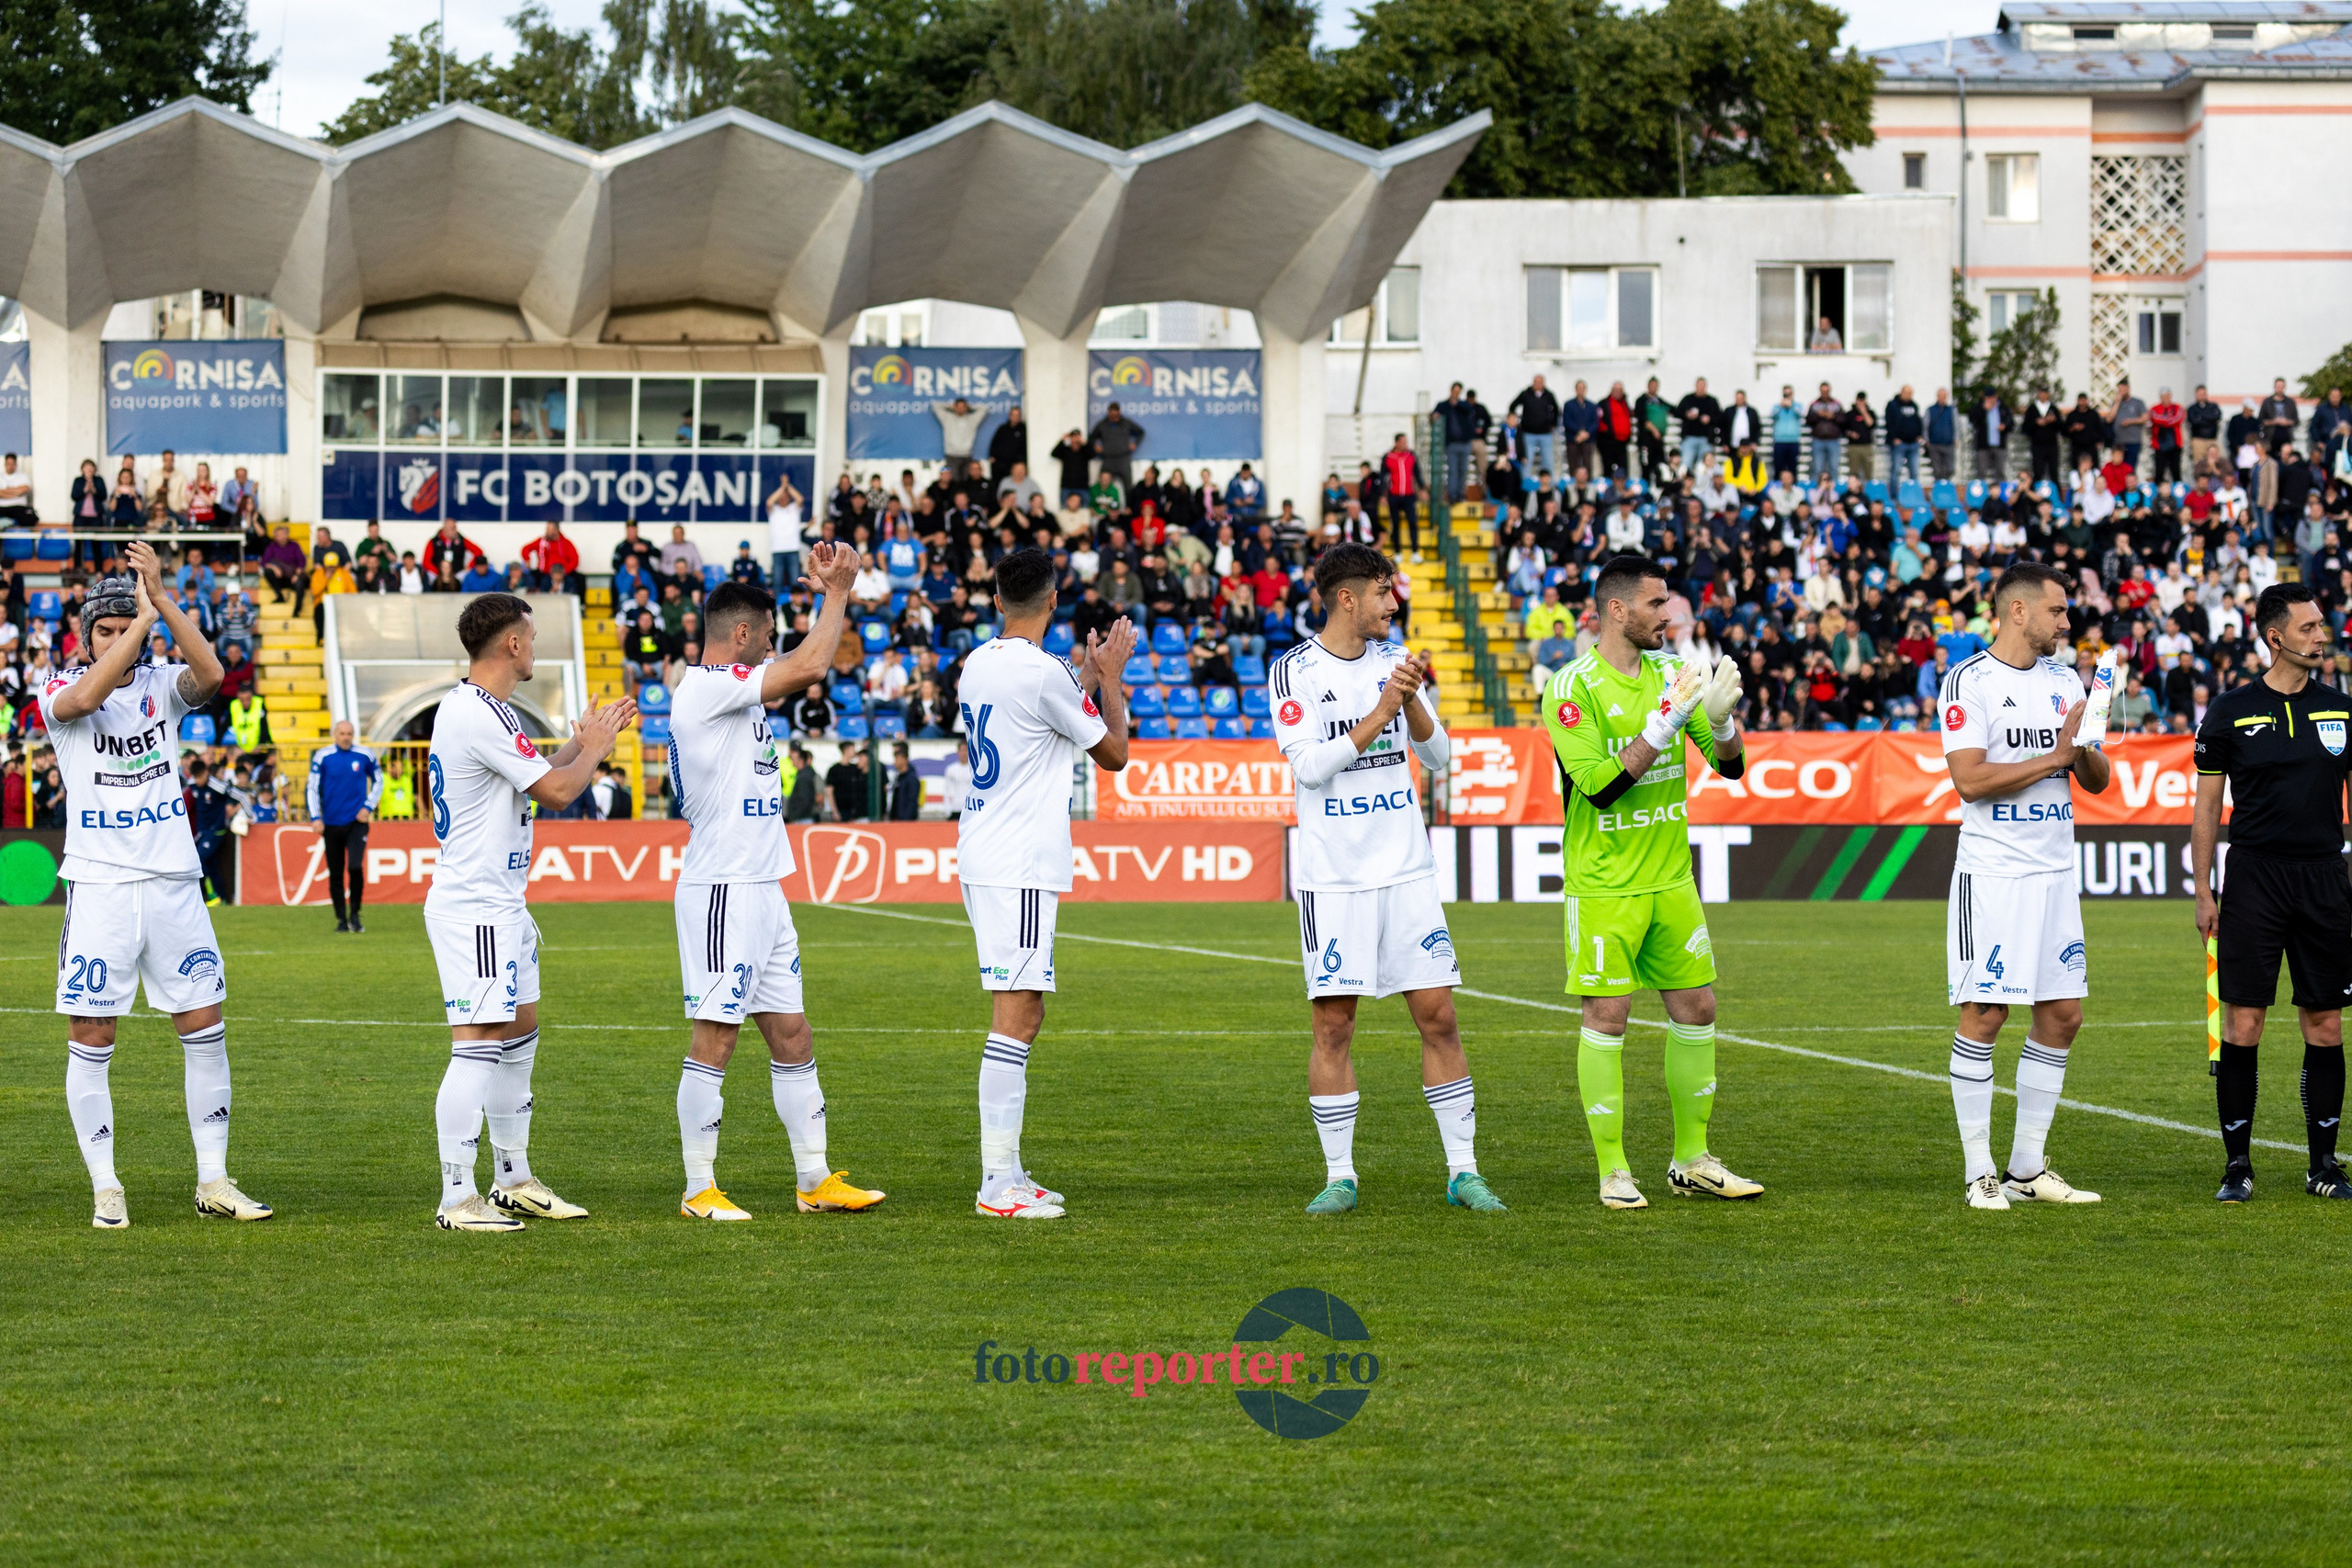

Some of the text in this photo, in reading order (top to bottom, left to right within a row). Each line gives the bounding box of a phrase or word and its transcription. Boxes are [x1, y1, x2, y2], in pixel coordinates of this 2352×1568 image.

[0, 393, 30, 409] orts
[109, 392, 285, 411] aquapark & sports
[849, 399, 930, 417] aquapar
[1204, 399, 1260, 417] sports
[457, 469, 762, 514] FC BOTOȘANI
[2320, 723, 2344, 732] FIFA
[2007, 728, 2064, 749] UNIB
[1373, 756, 1391, 768] SPRE
[1656, 770, 1670, 781] SPRE
[81, 797, 187, 829] ELSACO
[508, 849, 530, 870] ELS
[1182, 845, 1253, 883] HD
[1323, 938, 1342, 973] 6
[1593, 935, 1604, 972] 1
[1985, 944, 2005, 980] 4
[67, 954, 107, 993] 20
[180, 961, 192, 974] FIVE
[980, 966, 1010, 975] art Eco
[506, 960, 517, 998] 3
[731, 963, 752, 999] 30
[1339, 976, 1363, 986] Vestra
[1607, 976, 1630, 986] Vestra
[2002, 986, 2028, 994] Vestra
[88, 998, 116, 1008] Vestra
[445, 998, 471, 1008] art Eco
[90, 1132, 112, 1143] adidas
